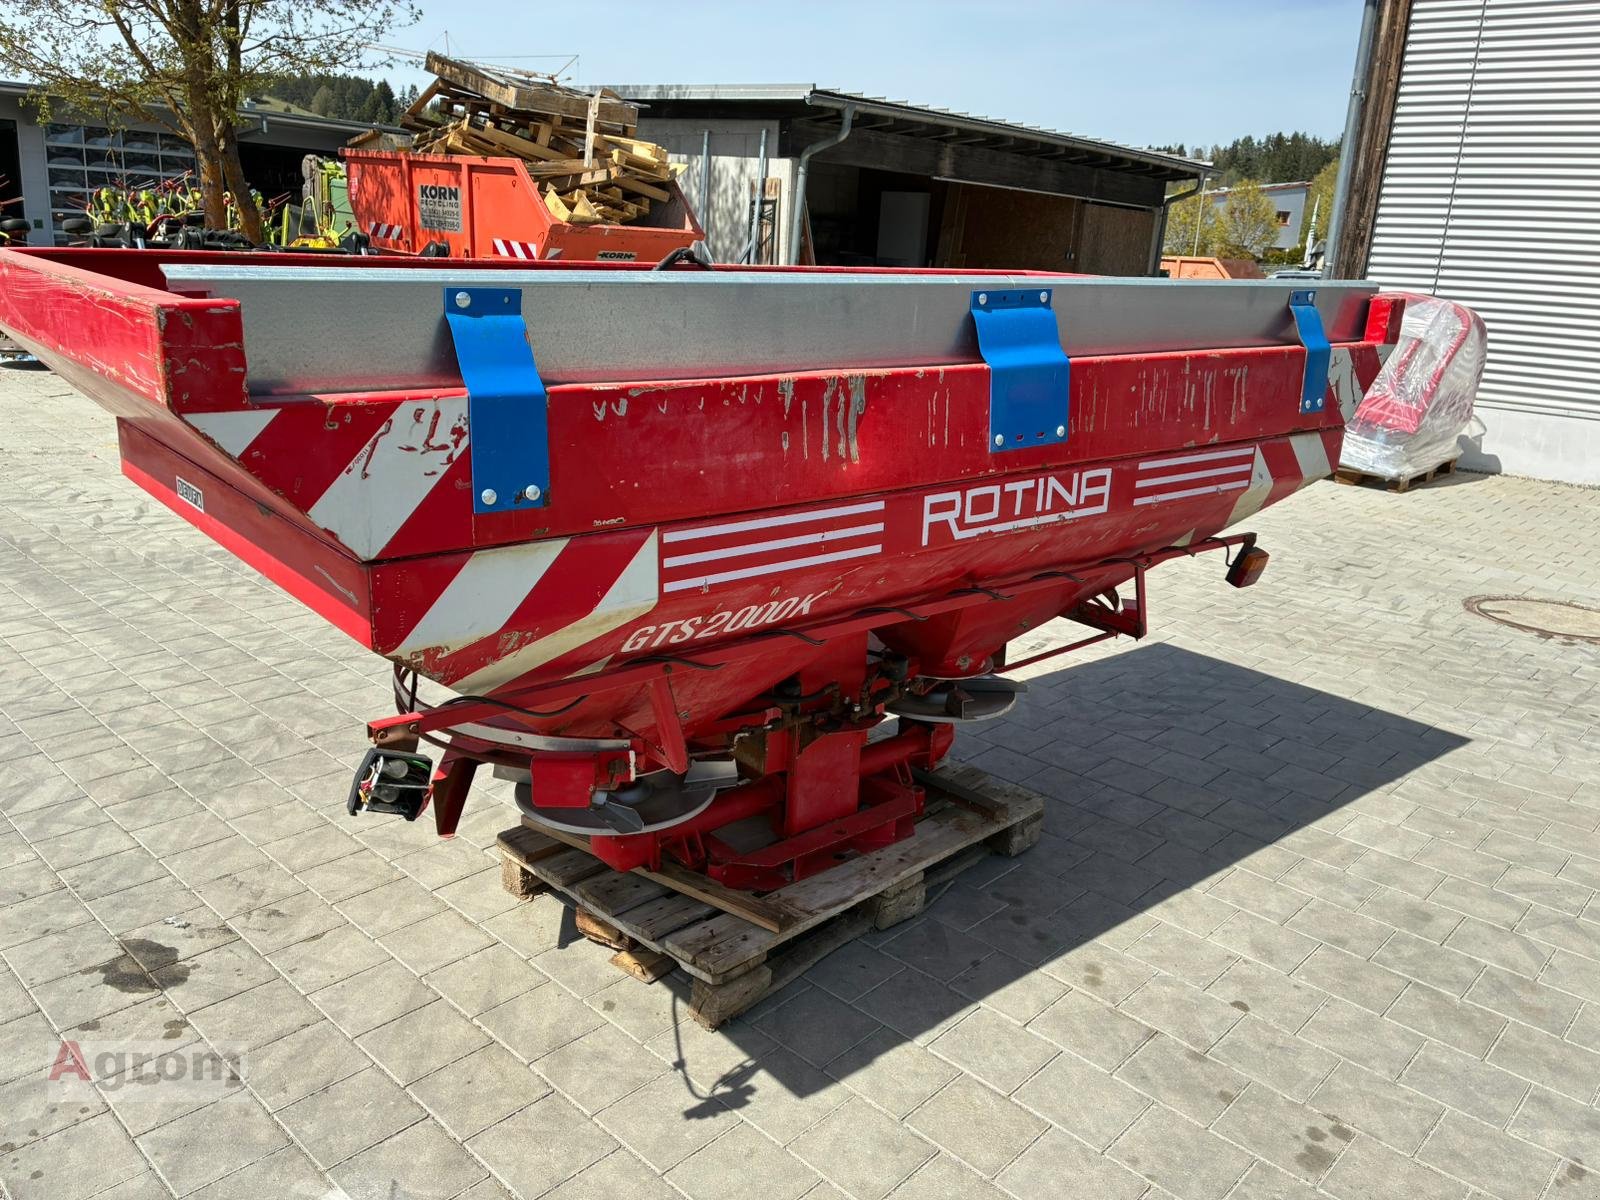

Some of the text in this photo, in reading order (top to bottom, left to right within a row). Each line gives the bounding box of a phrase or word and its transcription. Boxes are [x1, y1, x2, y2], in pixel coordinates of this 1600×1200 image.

[420, 184, 458, 201] KORN
[421, 198, 459, 208] RECYCLING
[599, 251, 635, 260] KORN
[922, 467, 1112, 547] ROTINA
